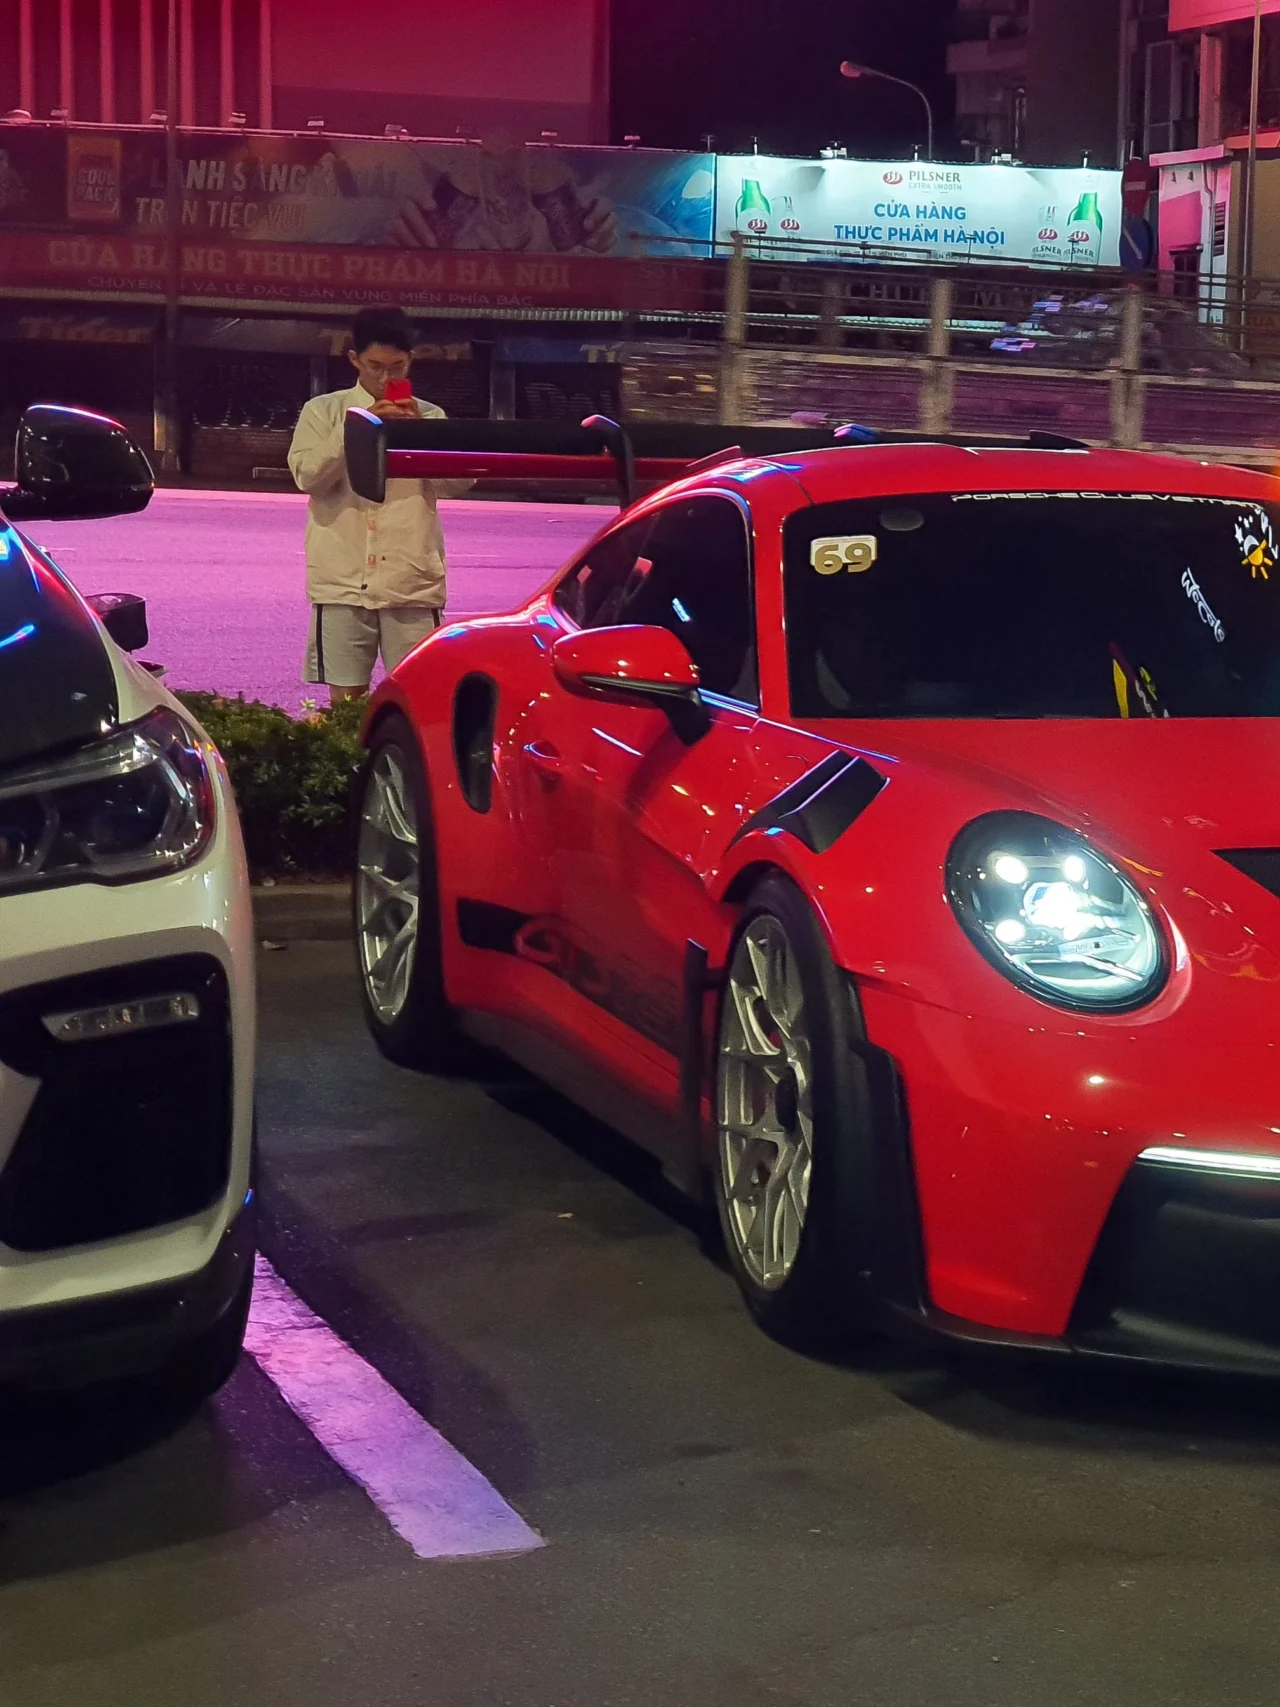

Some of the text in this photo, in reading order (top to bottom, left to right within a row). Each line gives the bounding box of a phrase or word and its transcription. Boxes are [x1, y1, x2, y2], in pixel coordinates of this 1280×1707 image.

[908, 170, 961, 182] PILSNER
[136, 196, 198, 227] TRN
[873, 199, 967, 220] CỬA HÀNG
[888, 223, 938, 243] PHẨM
[943, 225, 970, 244] HÀ
[973, 227, 1005, 249] NỘI
[318, 328, 470, 361] Ter
[814, 541, 873, 575] 69
